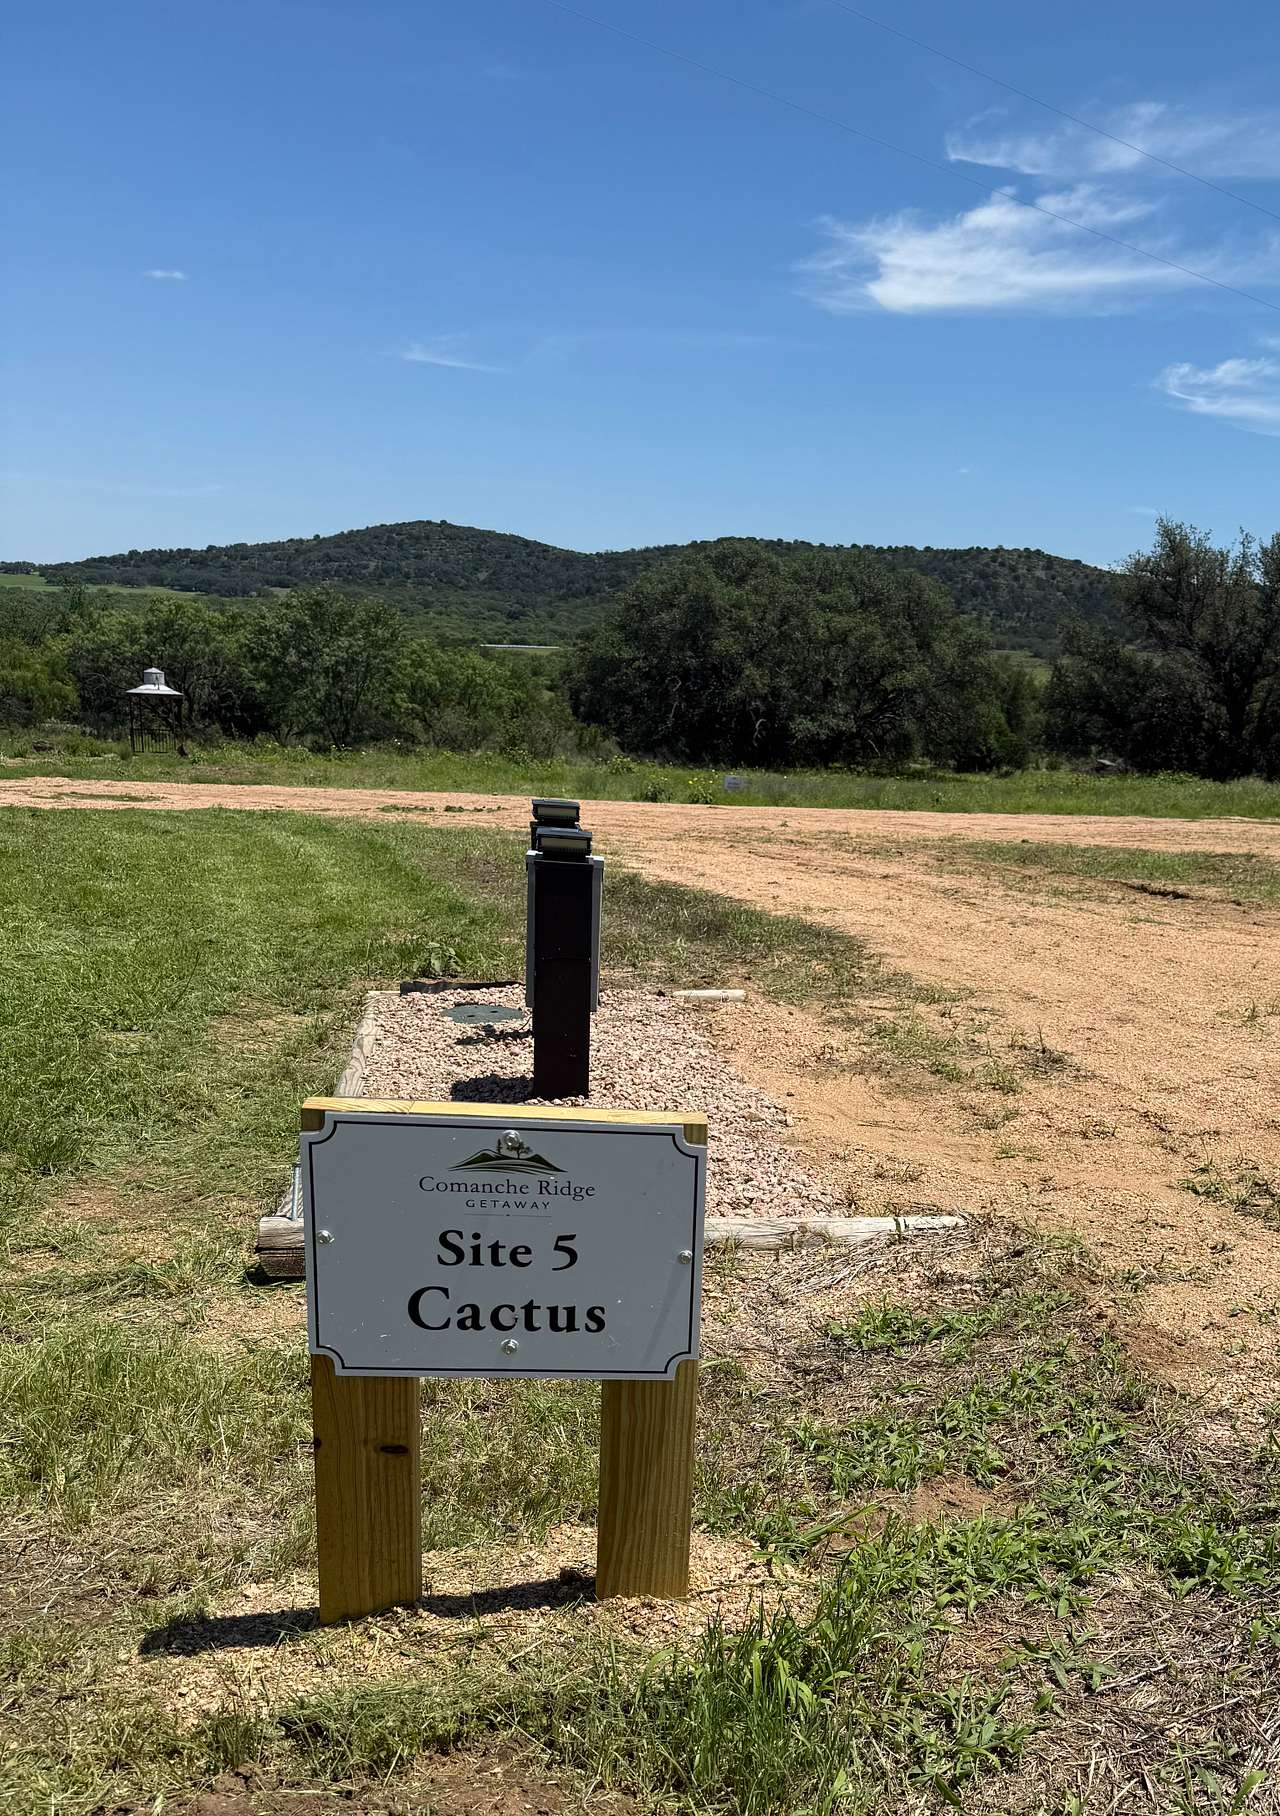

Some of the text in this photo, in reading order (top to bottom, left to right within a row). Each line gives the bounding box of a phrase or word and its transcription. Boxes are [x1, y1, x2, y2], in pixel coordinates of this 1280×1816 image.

[418, 1176, 596, 1201] Comanche Ridge
[465, 1199, 551, 1210] GETAWAY
[437, 1230, 579, 1271] Site 5
[407, 1286, 607, 1333] Cactus
